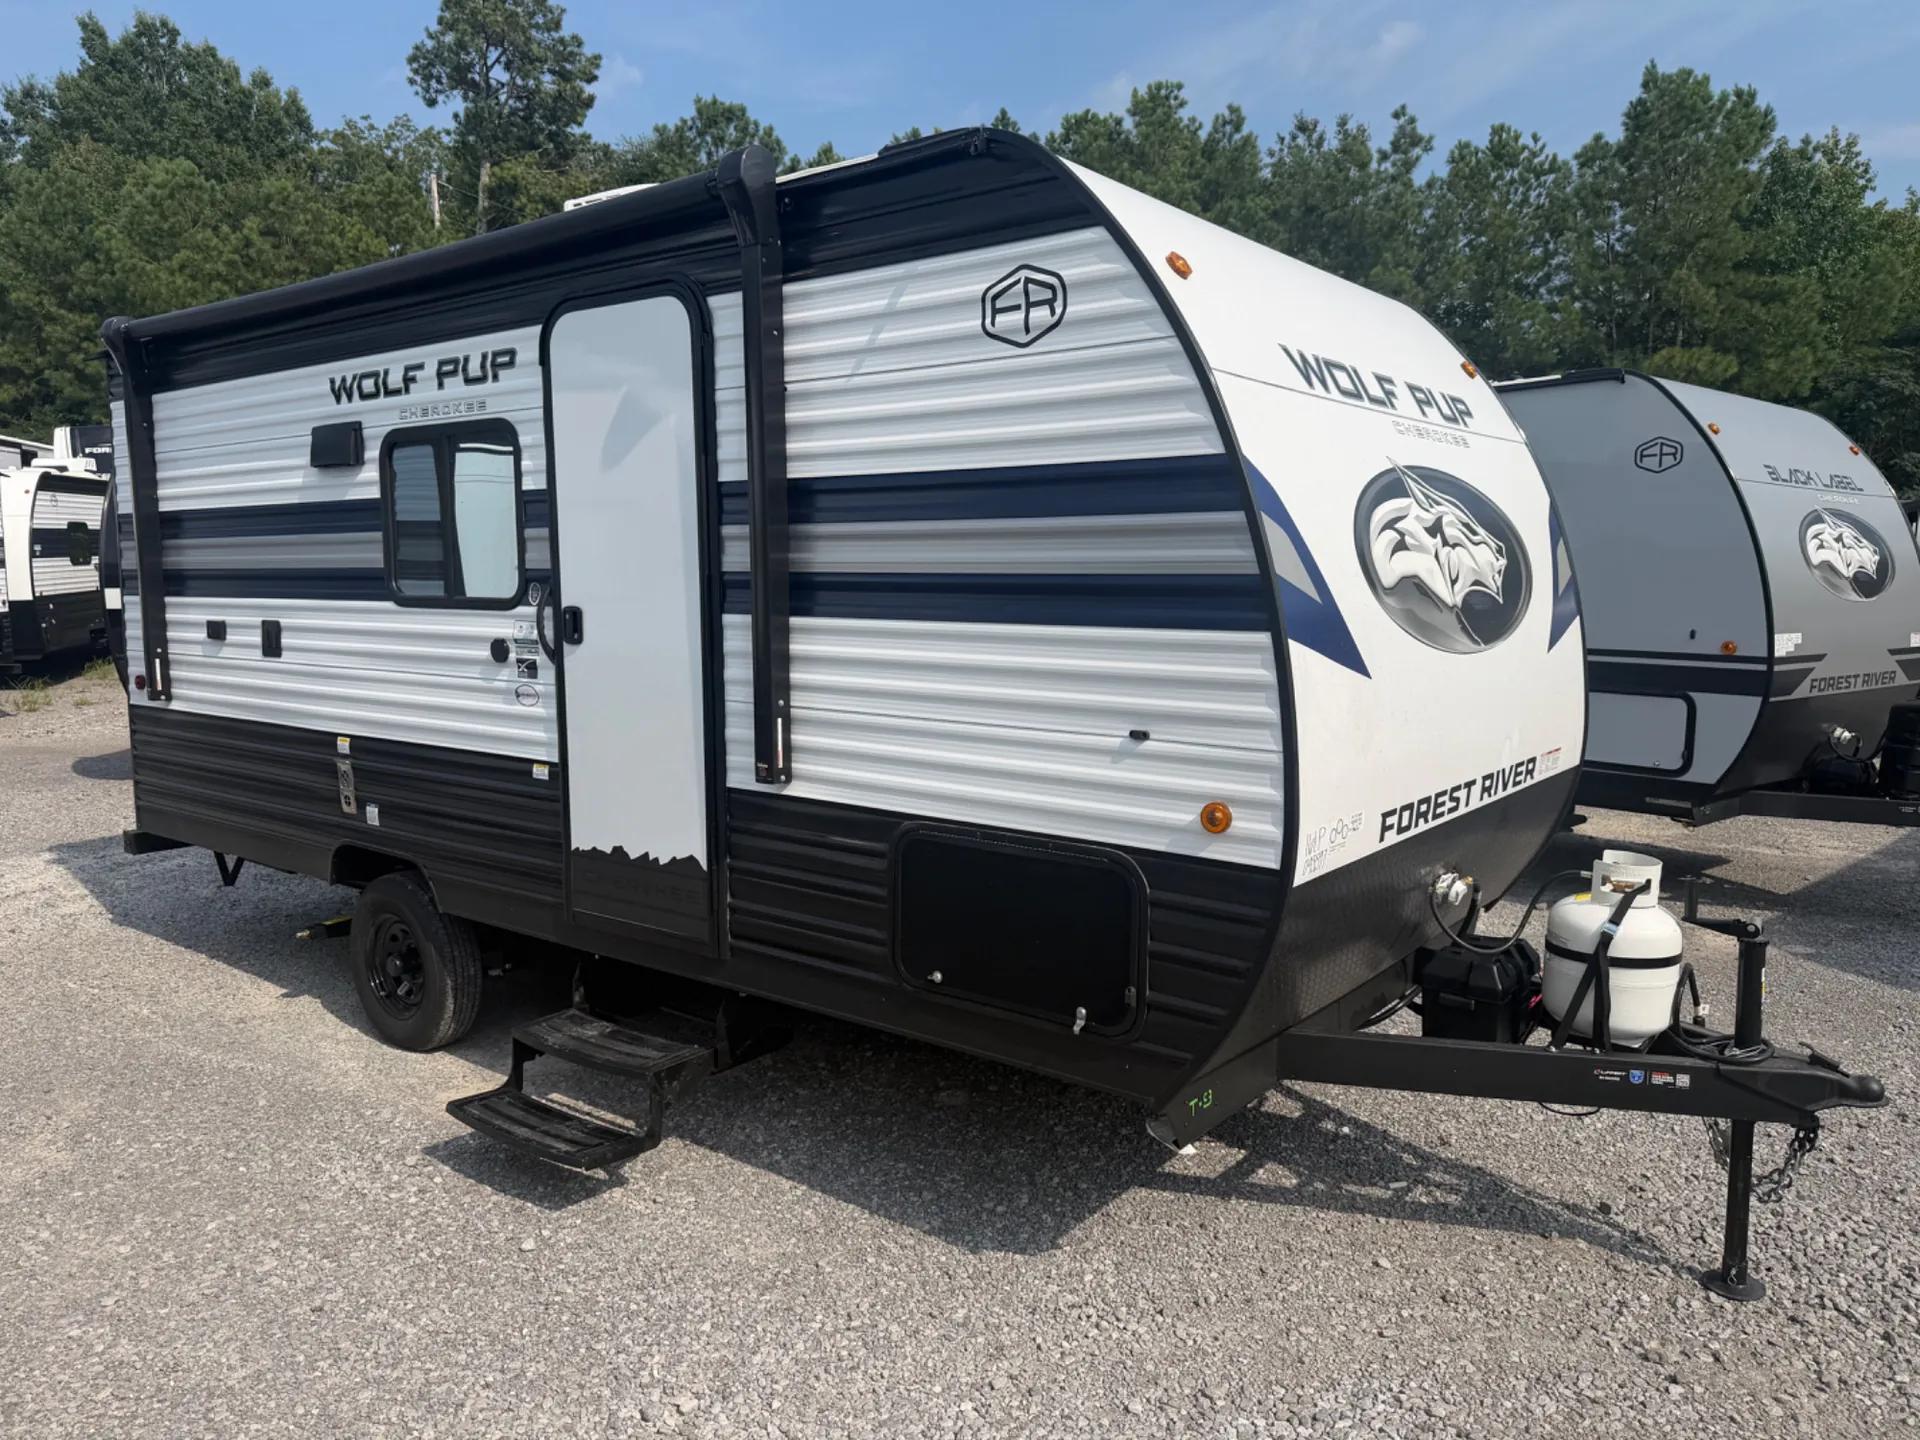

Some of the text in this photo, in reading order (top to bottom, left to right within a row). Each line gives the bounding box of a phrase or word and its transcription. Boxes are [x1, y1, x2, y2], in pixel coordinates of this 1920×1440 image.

[328, 347, 517, 405] WOLF PUP
[1277, 342, 1474, 428] WOLF PUP
[399, 399, 487, 421] CHEROKEE
[1391, 420, 1471, 448] CHEROKEE
[85, 446, 112, 454] FOR
[1763, 463, 1864, 492] BLACK LABEL
[1809, 670, 1897, 694] FOREST RIVER
[1378, 778, 1477, 843] FOREST
[1479, 756, 1537, 802] RIVER
